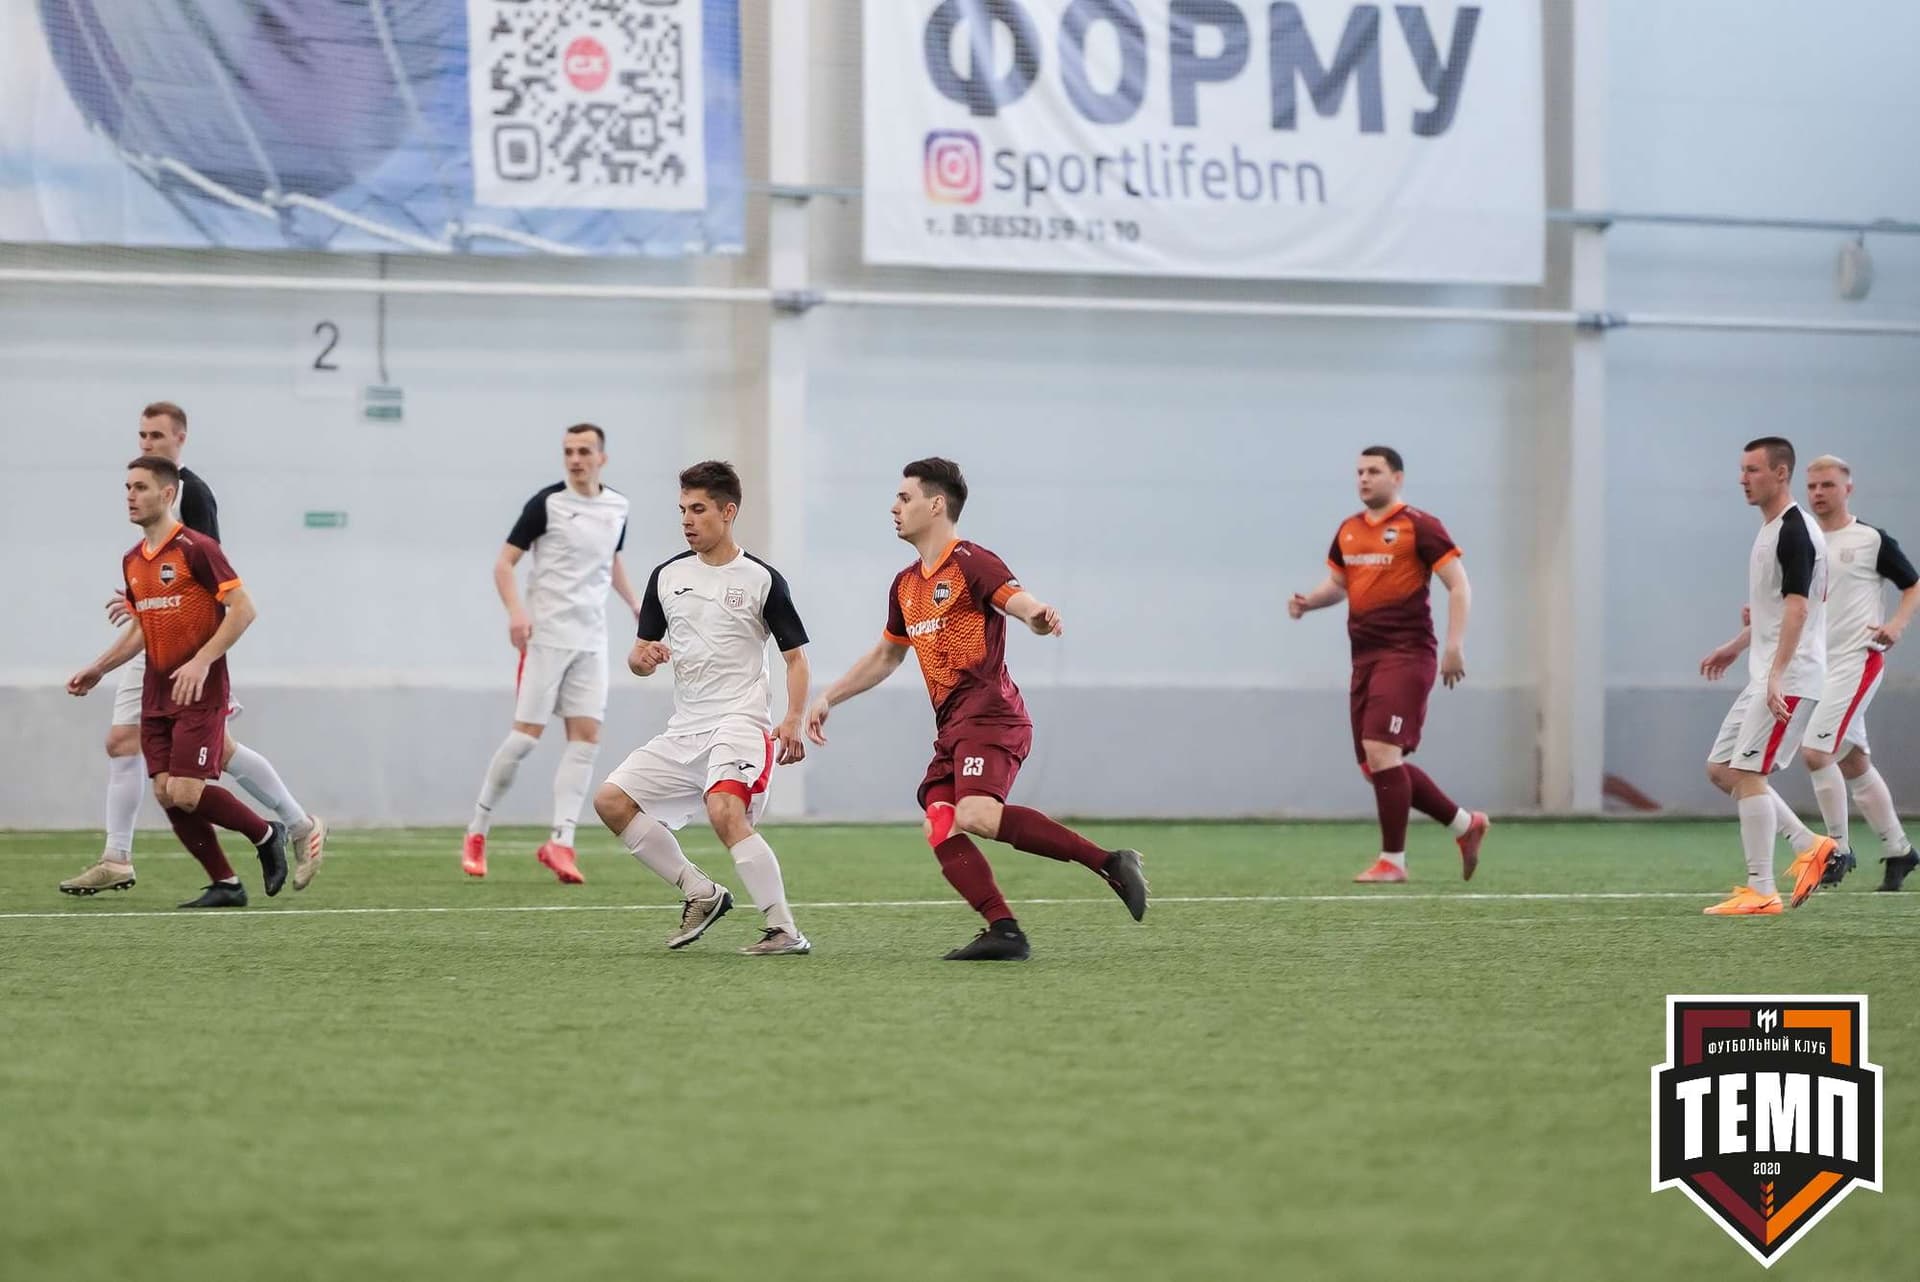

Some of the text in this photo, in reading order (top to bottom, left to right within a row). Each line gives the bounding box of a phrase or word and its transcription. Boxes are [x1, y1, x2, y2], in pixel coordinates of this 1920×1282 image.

[923, 0, 1482, 137] ФОРМУ
[993, 139, 1327, 207] sportlifebrn
[314, 321, 340, 370] 2
[1389, 714, 1404, 735] 13
[962, 756, 985, 777] 23
